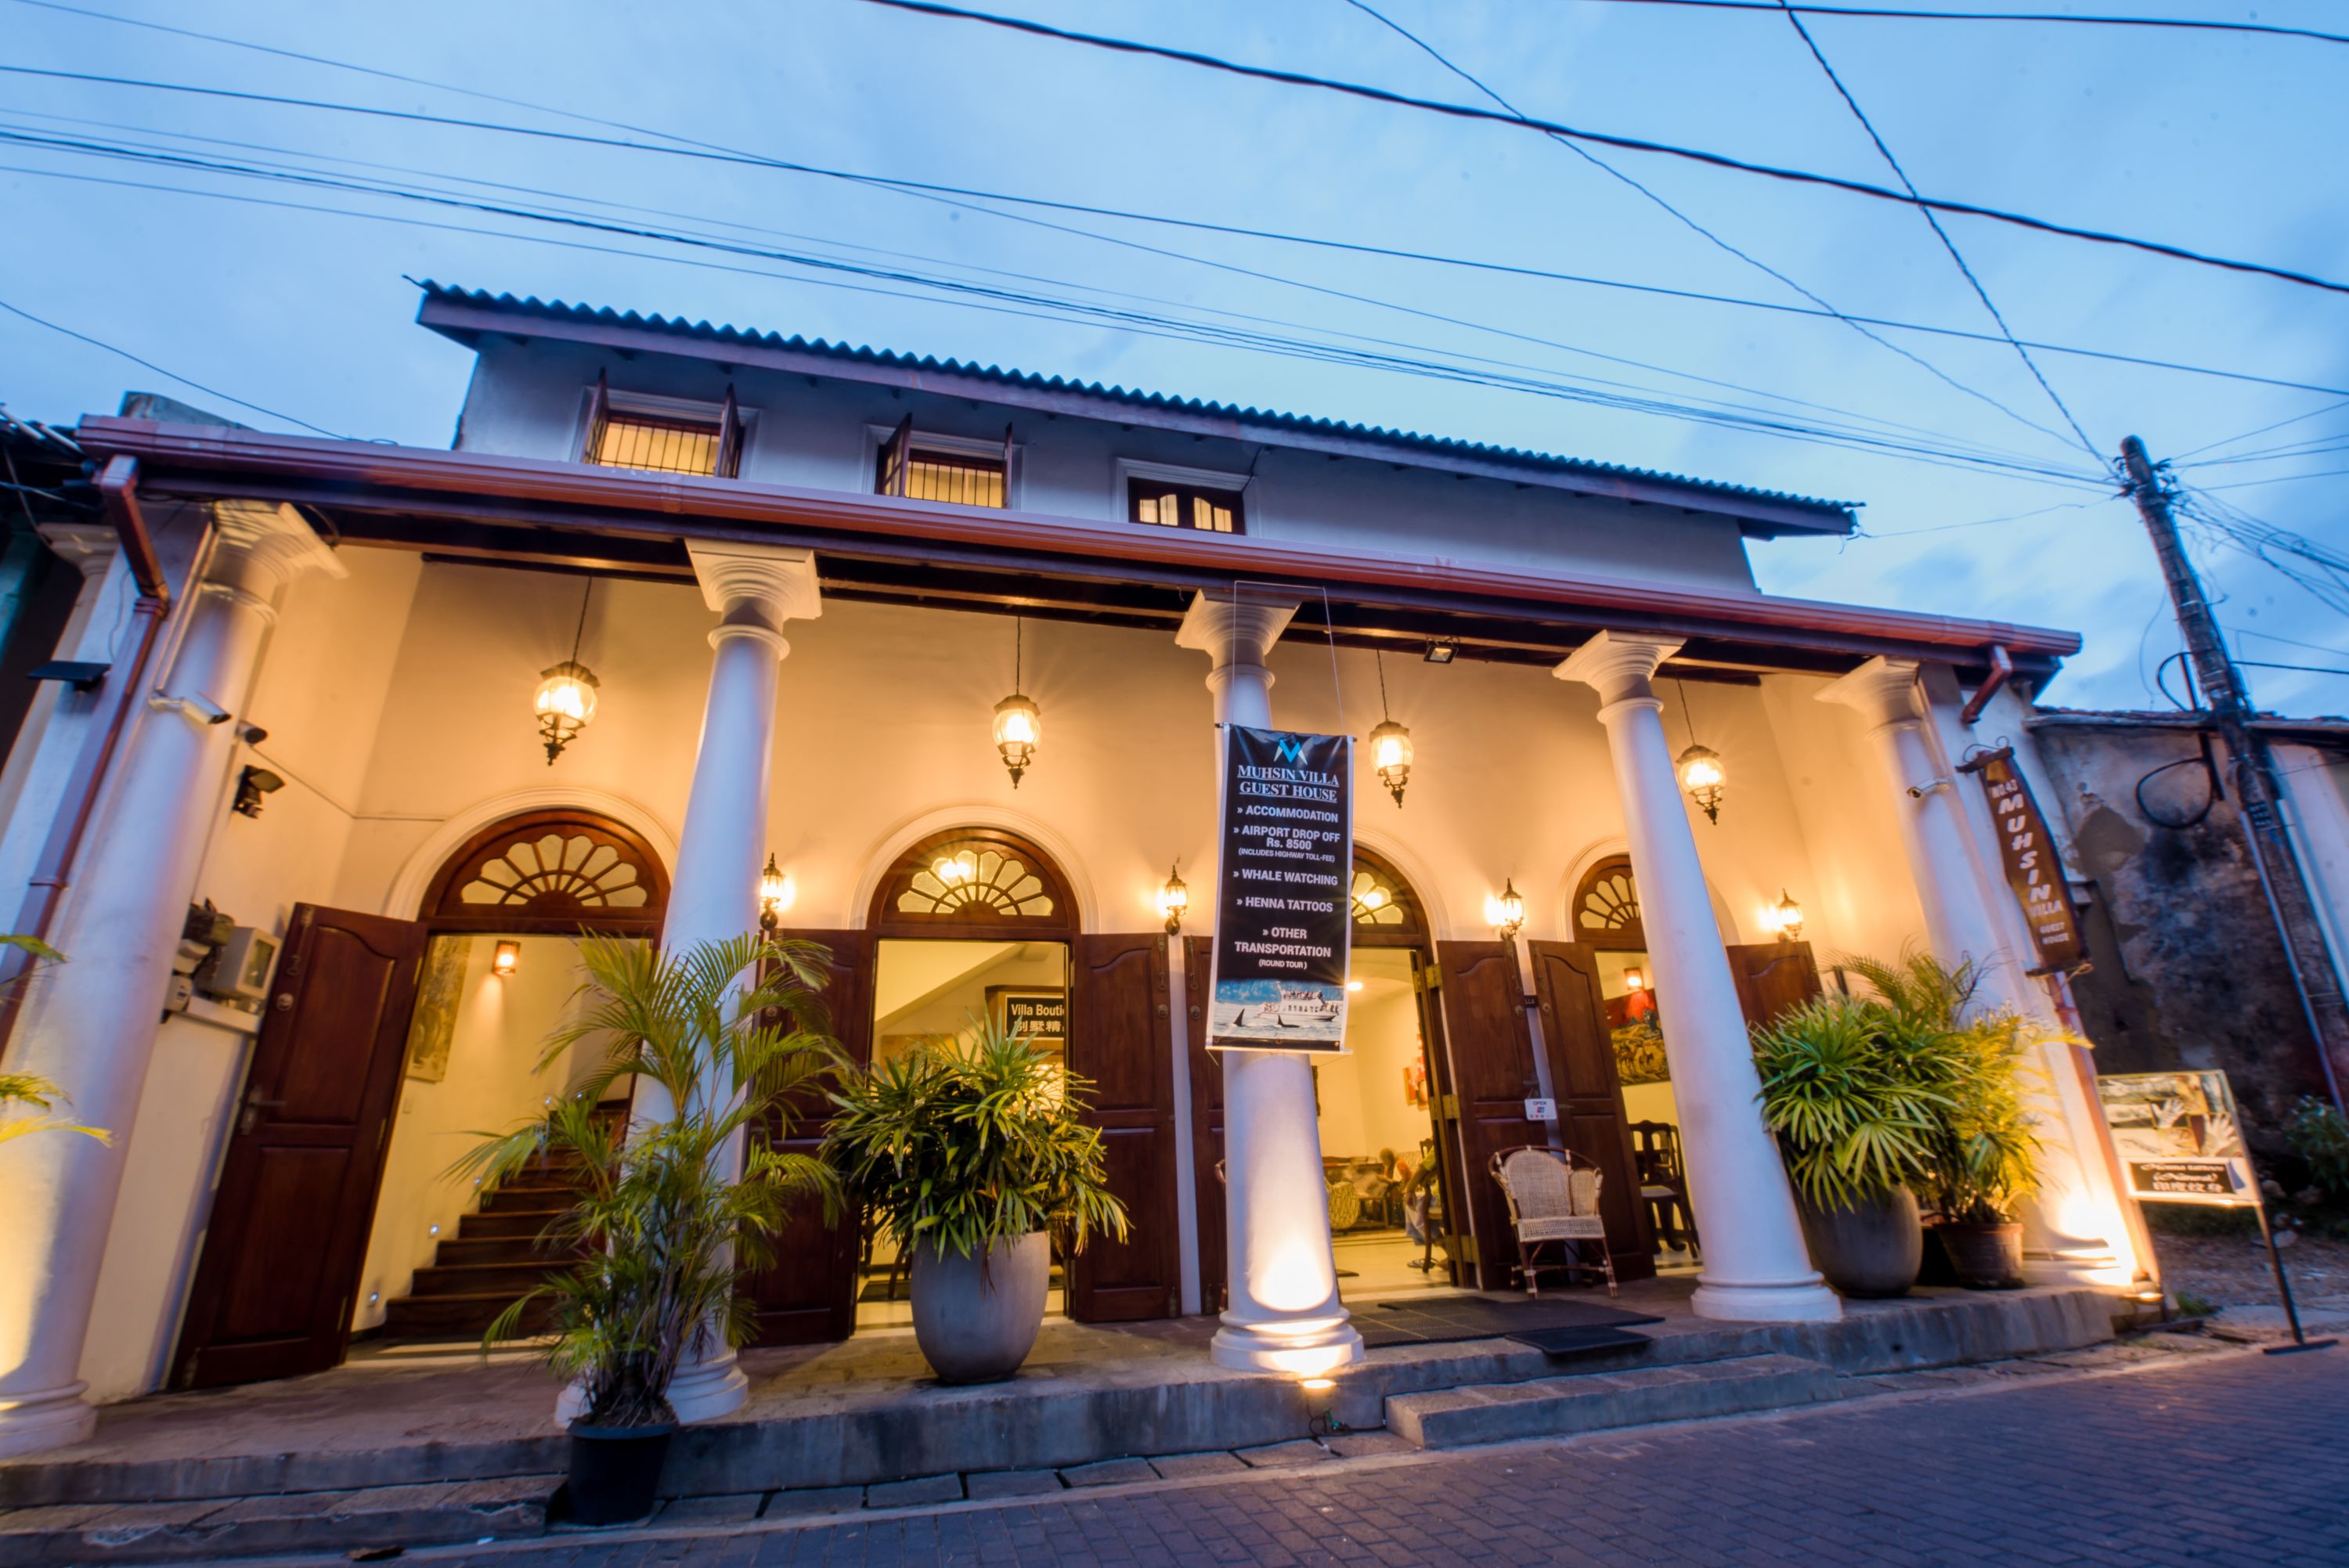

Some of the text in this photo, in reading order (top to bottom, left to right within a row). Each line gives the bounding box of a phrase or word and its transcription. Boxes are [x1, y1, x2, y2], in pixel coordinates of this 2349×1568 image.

[1237, 765, 1339, 785] MUHSIN VILLA
[1239, 781, 1337, 801] GUEST HOUSE
[1245, 805, 1338, 823] ACCOMMODATION
[1242, 824, 1340, 842] AIRPORT DROP OFF
[1266, 837, 1312, 850] Rs. 8500
[1998, 793, 2051, 903] MUHSIN
[1238, 847, 1335, 863] (INCLUDES HIGHWAY TOLL-FEE)
[1242, 868, 1338, 885] WHALE WATCHING
[1245, 896, 1333, 912] HENNA TATTOOS
[2029, 899, 2064, 917] VILLA
[1271, 927, 1308, 939] OTHER
[1234, 941, 1331, 957] TRANSPORTATION
[1258, 959, 1285, 968] (ROUND
[1011, 1004, 1034, 1016] Villa
